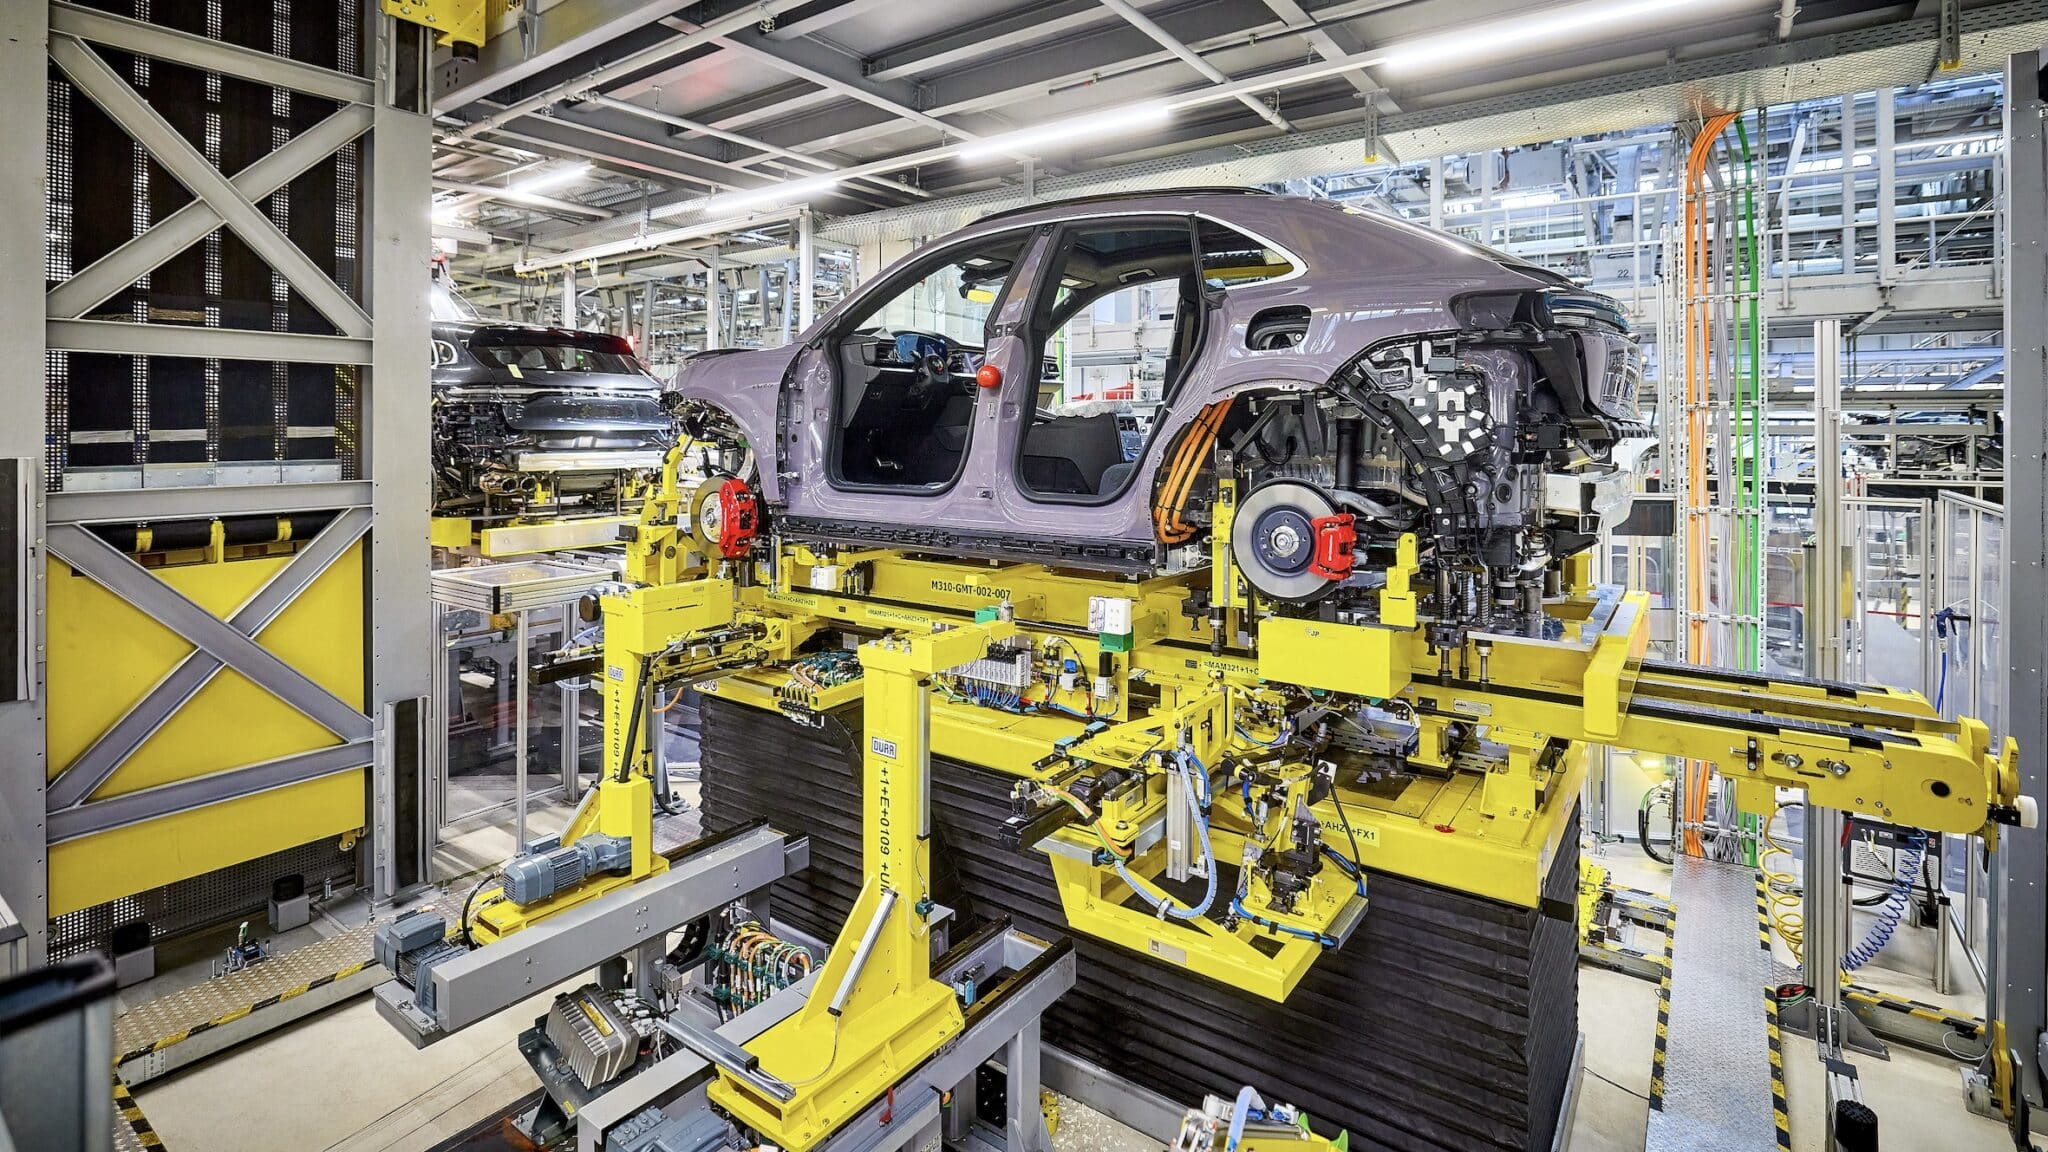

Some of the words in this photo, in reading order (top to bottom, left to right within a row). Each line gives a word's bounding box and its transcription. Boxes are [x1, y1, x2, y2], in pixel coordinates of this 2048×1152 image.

[1617, 269, 1629, 279] 22
[931, 580, 1011, 600] M310-GMT-002-007
[880, 767, 890, 856] +1+E+0109
[1320, 819, 1376, 841] +AHZ+FX1
